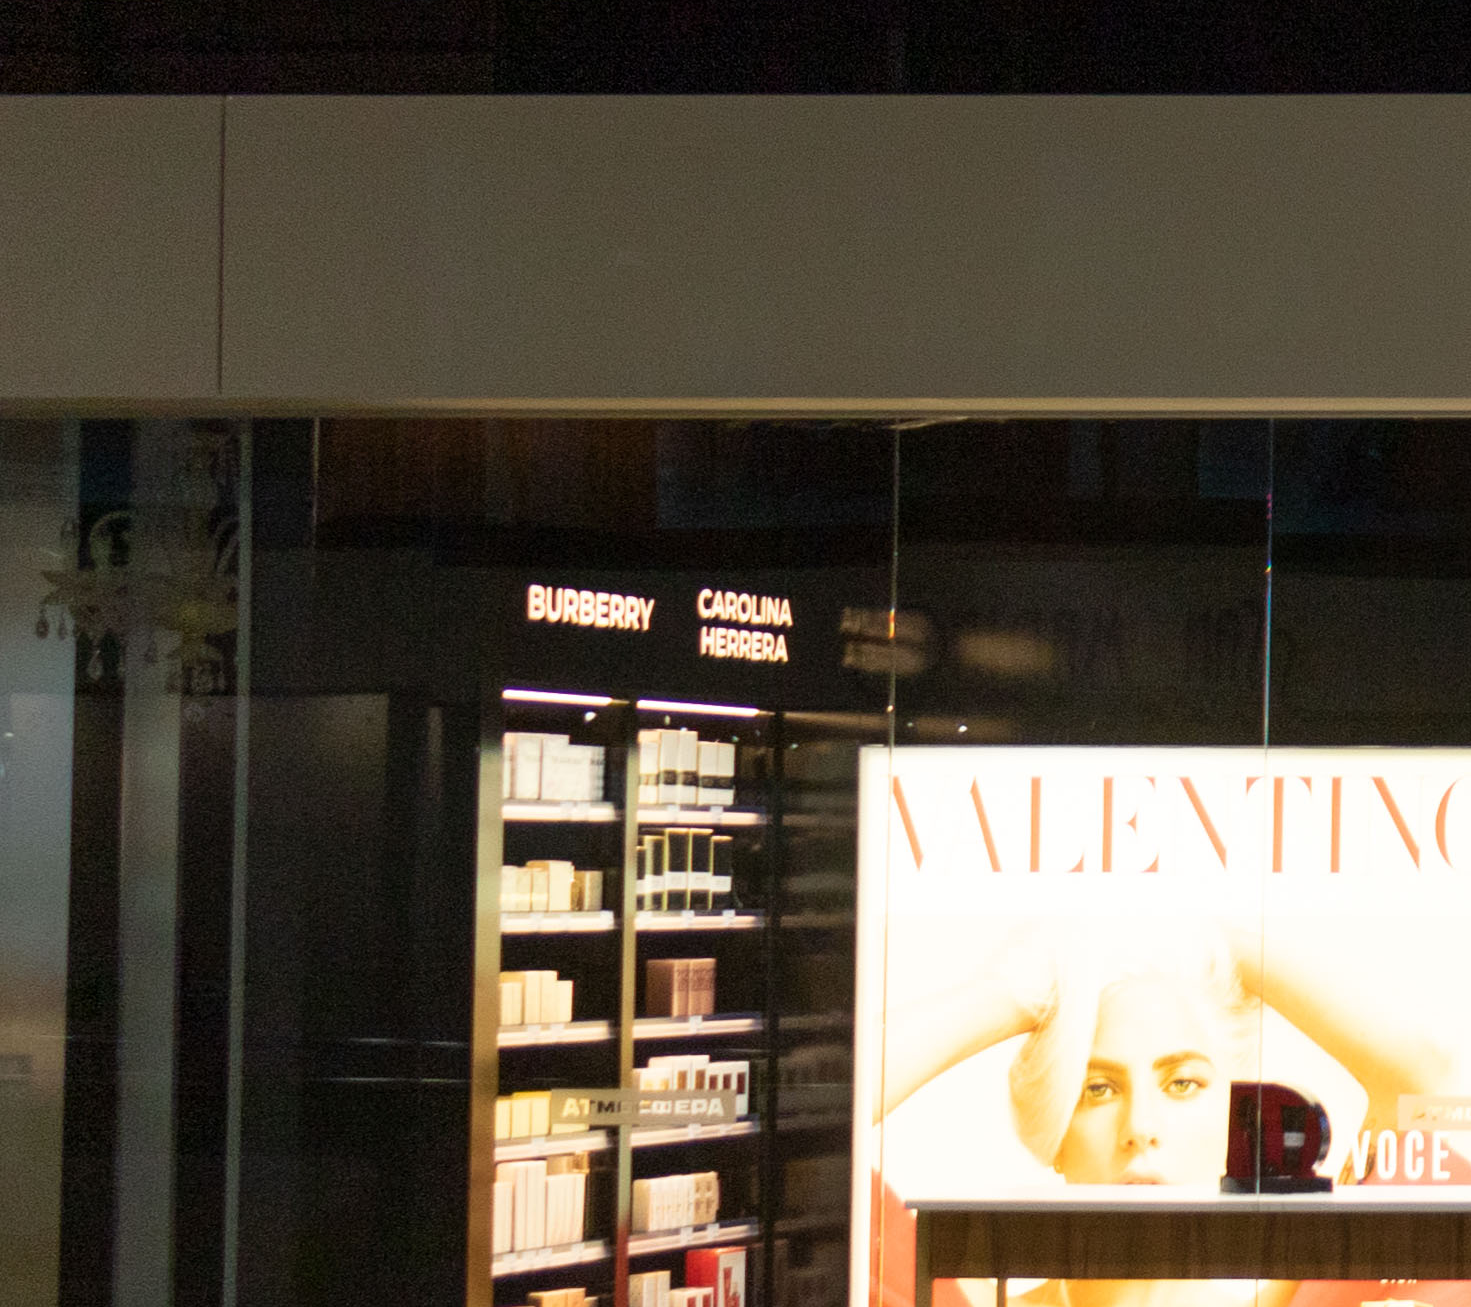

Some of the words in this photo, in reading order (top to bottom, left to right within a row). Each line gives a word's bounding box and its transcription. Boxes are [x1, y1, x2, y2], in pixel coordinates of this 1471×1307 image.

[527, 584, 655, 631] BURBERRY
[697, 588, 793, 627] CAROLINA
[699, 626, 789, 663] HERRERA
[1352, 1129, 1451, 1181] VOCE
